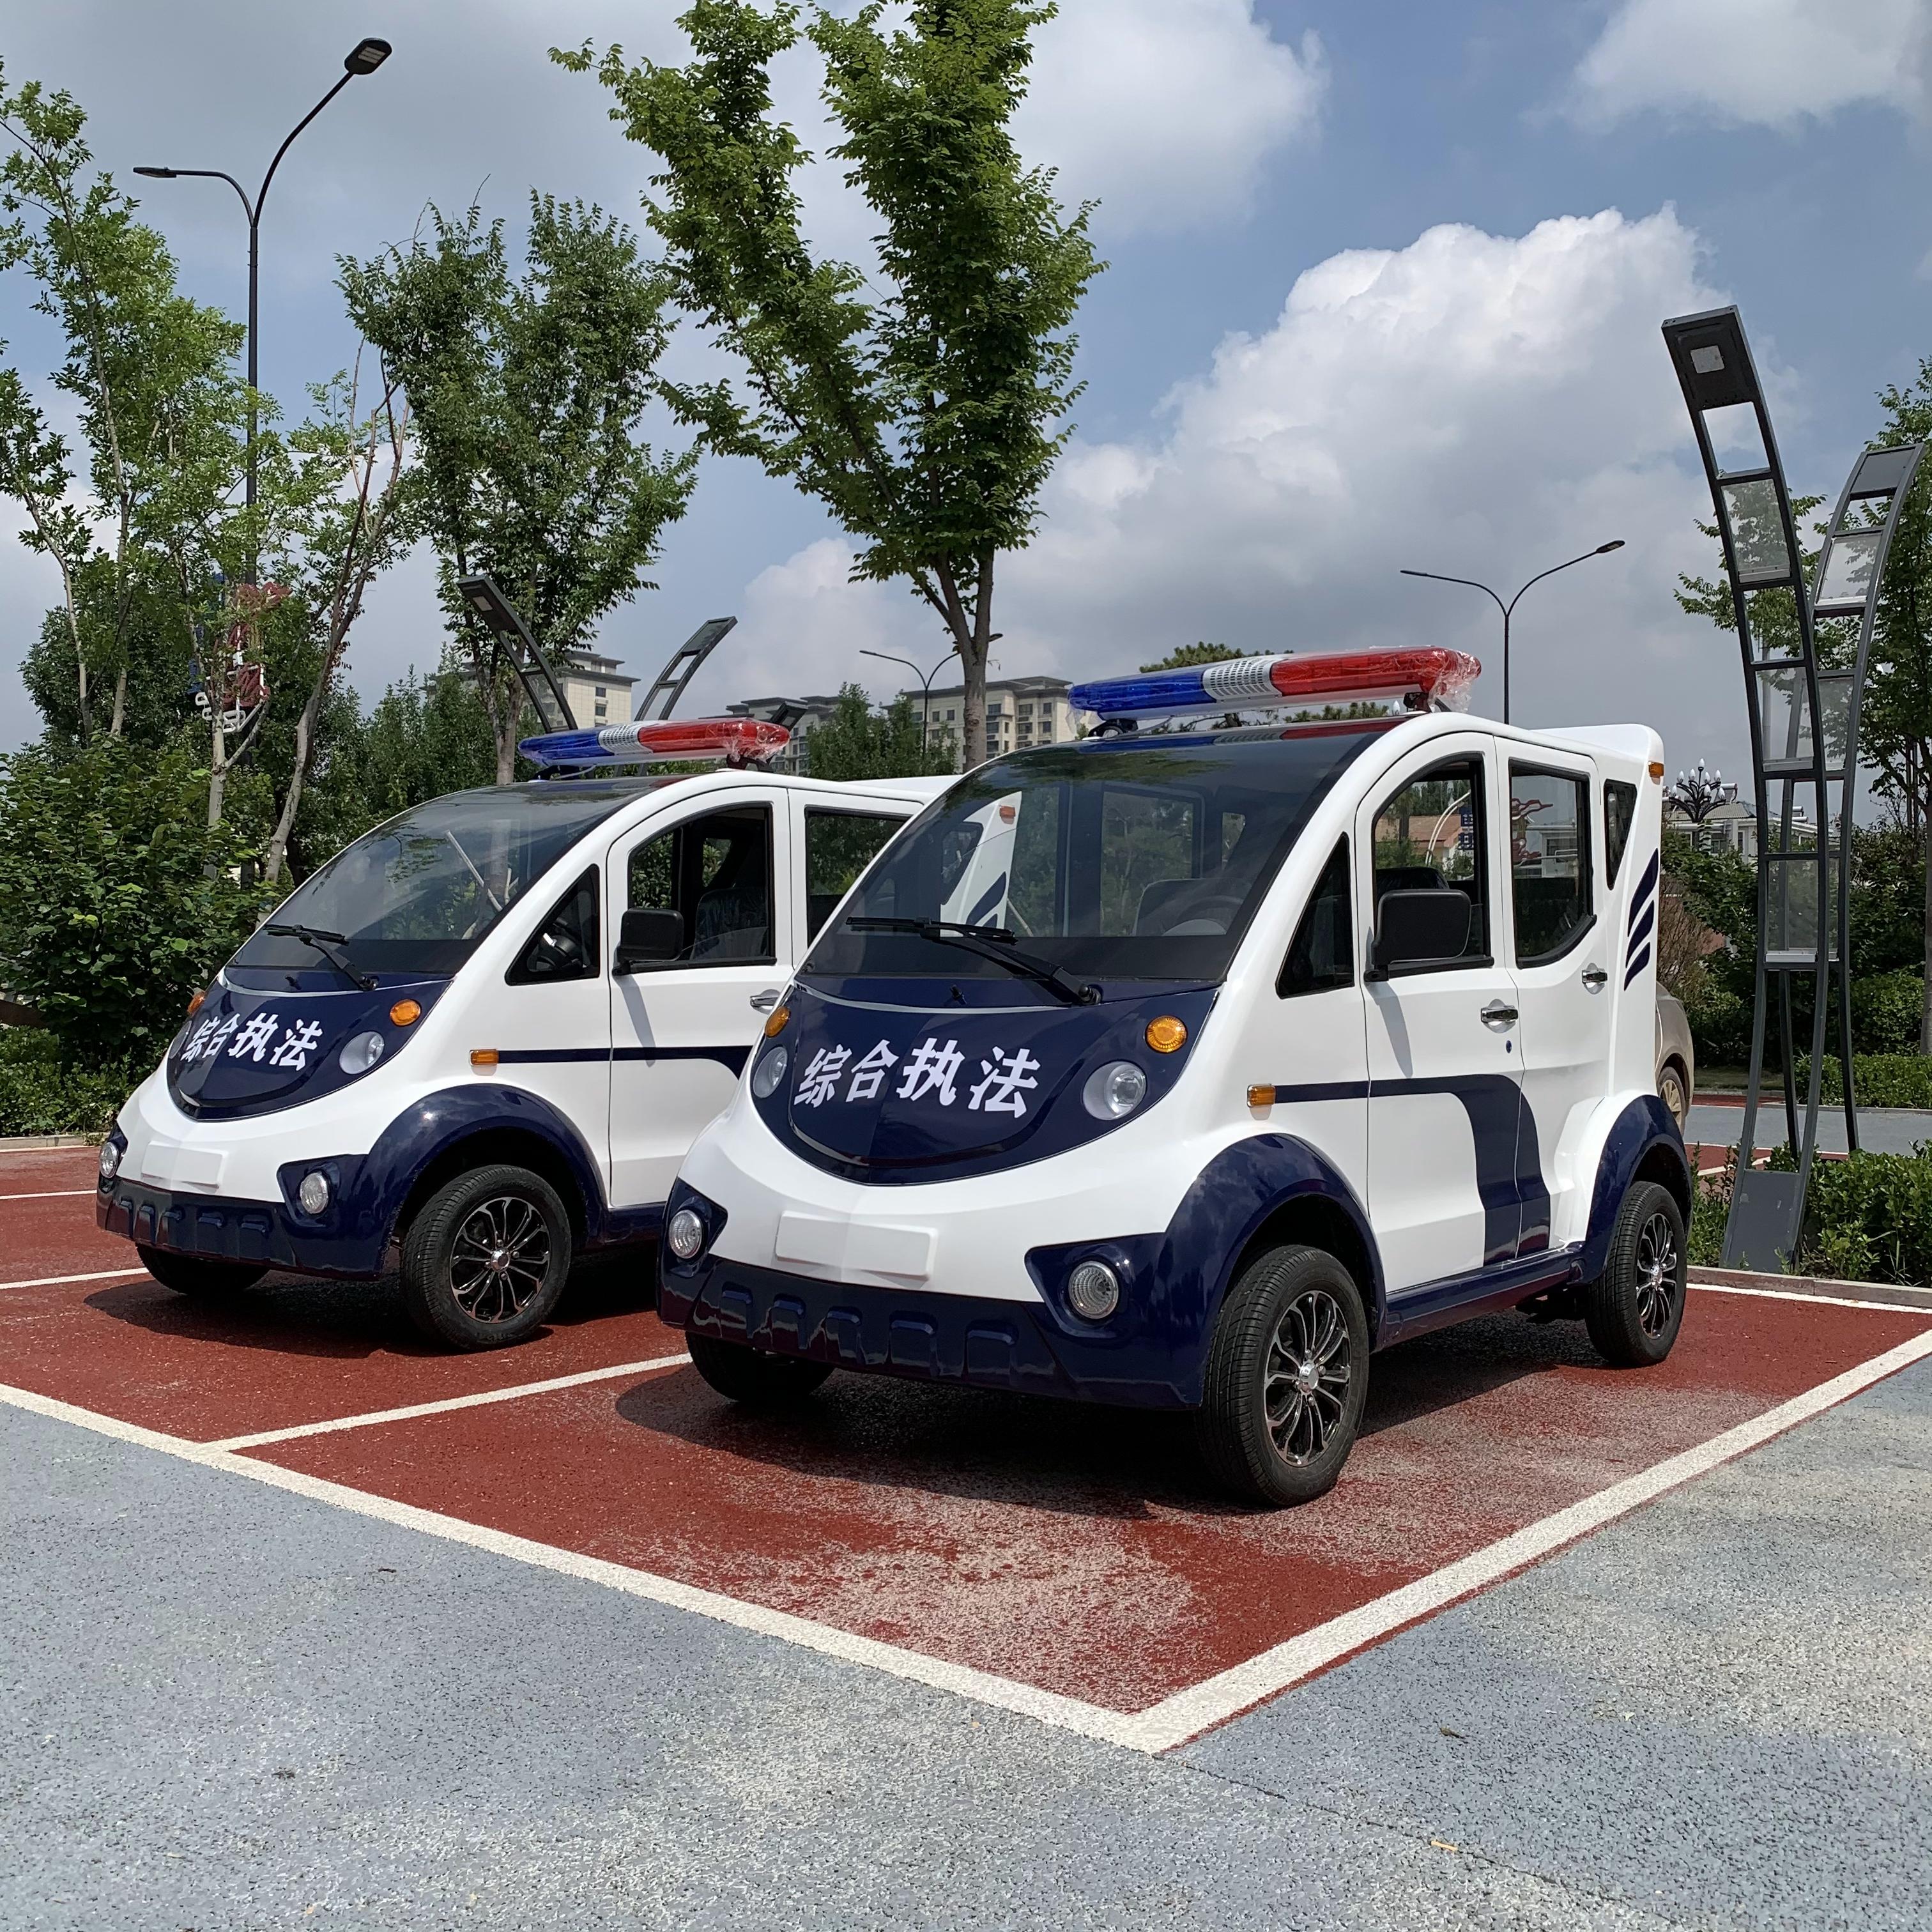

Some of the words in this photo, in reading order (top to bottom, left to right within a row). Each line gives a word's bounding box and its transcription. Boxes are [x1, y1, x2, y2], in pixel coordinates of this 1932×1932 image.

[180, 1012, 323, 1072] 综合执法
[793, 1038, 1041, 1119] 综合执法
